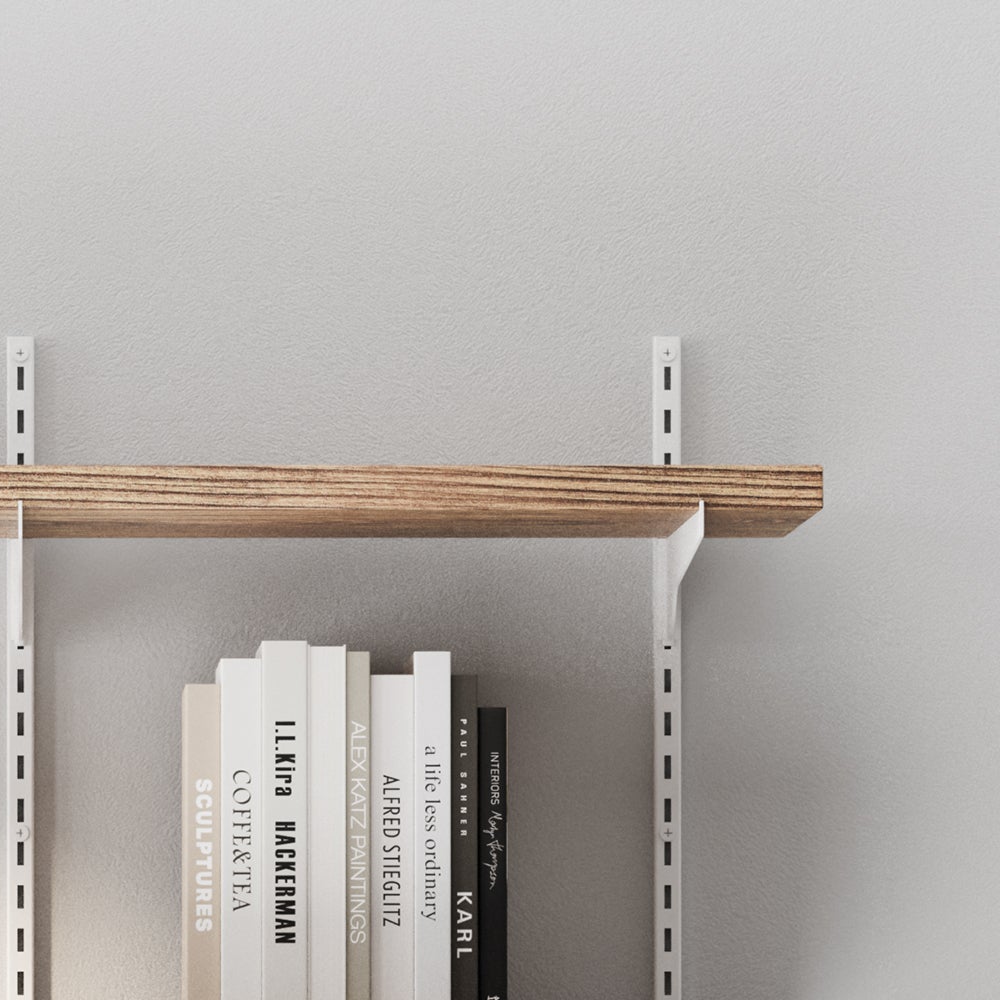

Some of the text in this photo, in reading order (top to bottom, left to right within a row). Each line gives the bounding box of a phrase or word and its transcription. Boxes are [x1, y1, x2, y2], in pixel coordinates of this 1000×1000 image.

[195, 779, 213, 933] SCULPTURES
[232, 770, 252, 912] COFFE&TEA
[275, 721, 297, 944] I.L.Kira HACKERMAN
[350, 720, 367, 944] ALEX KATZ PAINTINGS
[383, 774, 401, 927] ALFRED STIEGLITZ
[420, 745, 441, 922] a life less ordinary
[456, 718, 473, 959] PAUL SAHNER KARL
[490, 752, 500, 806] INTERIORS
[483, 839, 504, 890] Thompson
